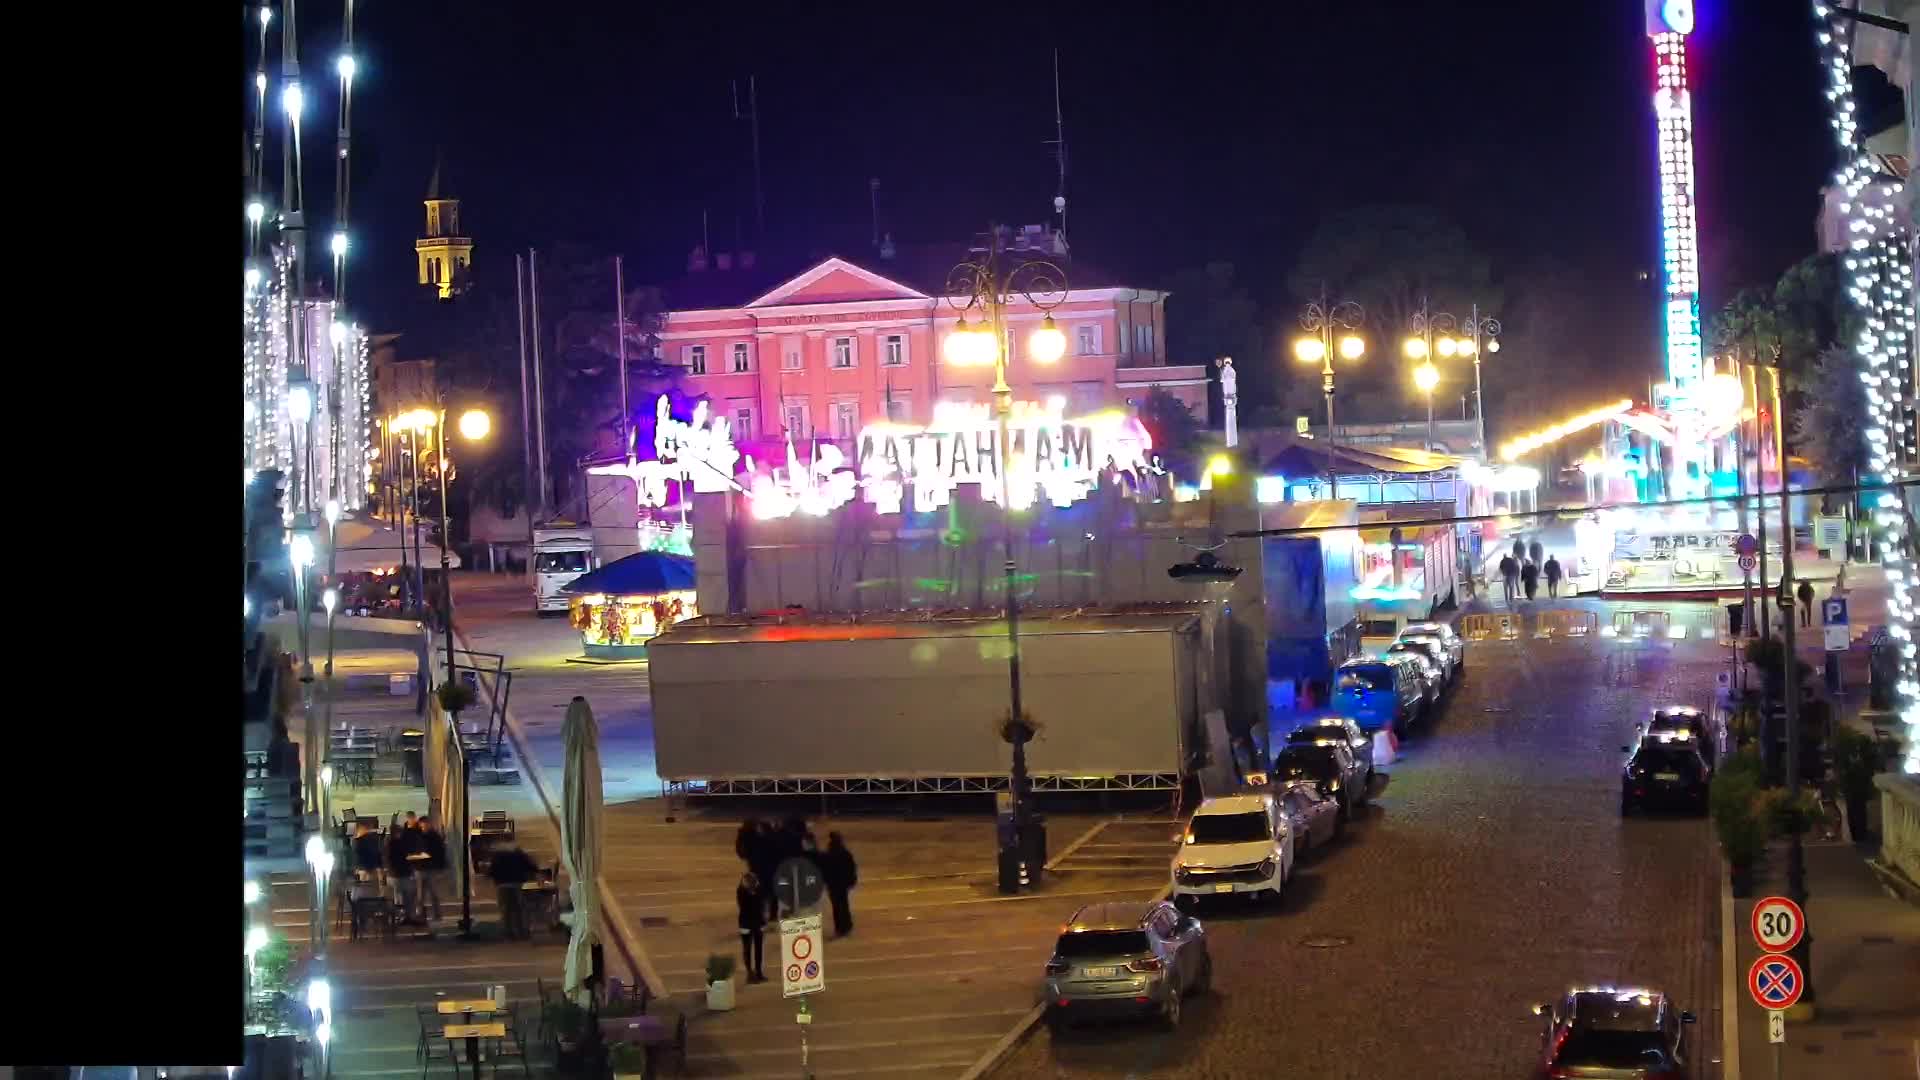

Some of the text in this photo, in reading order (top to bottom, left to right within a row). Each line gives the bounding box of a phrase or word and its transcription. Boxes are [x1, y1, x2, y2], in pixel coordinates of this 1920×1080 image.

[1743, 557, 1752, 567] 20
[1827, 603, 1841, 621] P
[1762, 912, 1791, 937] 30
